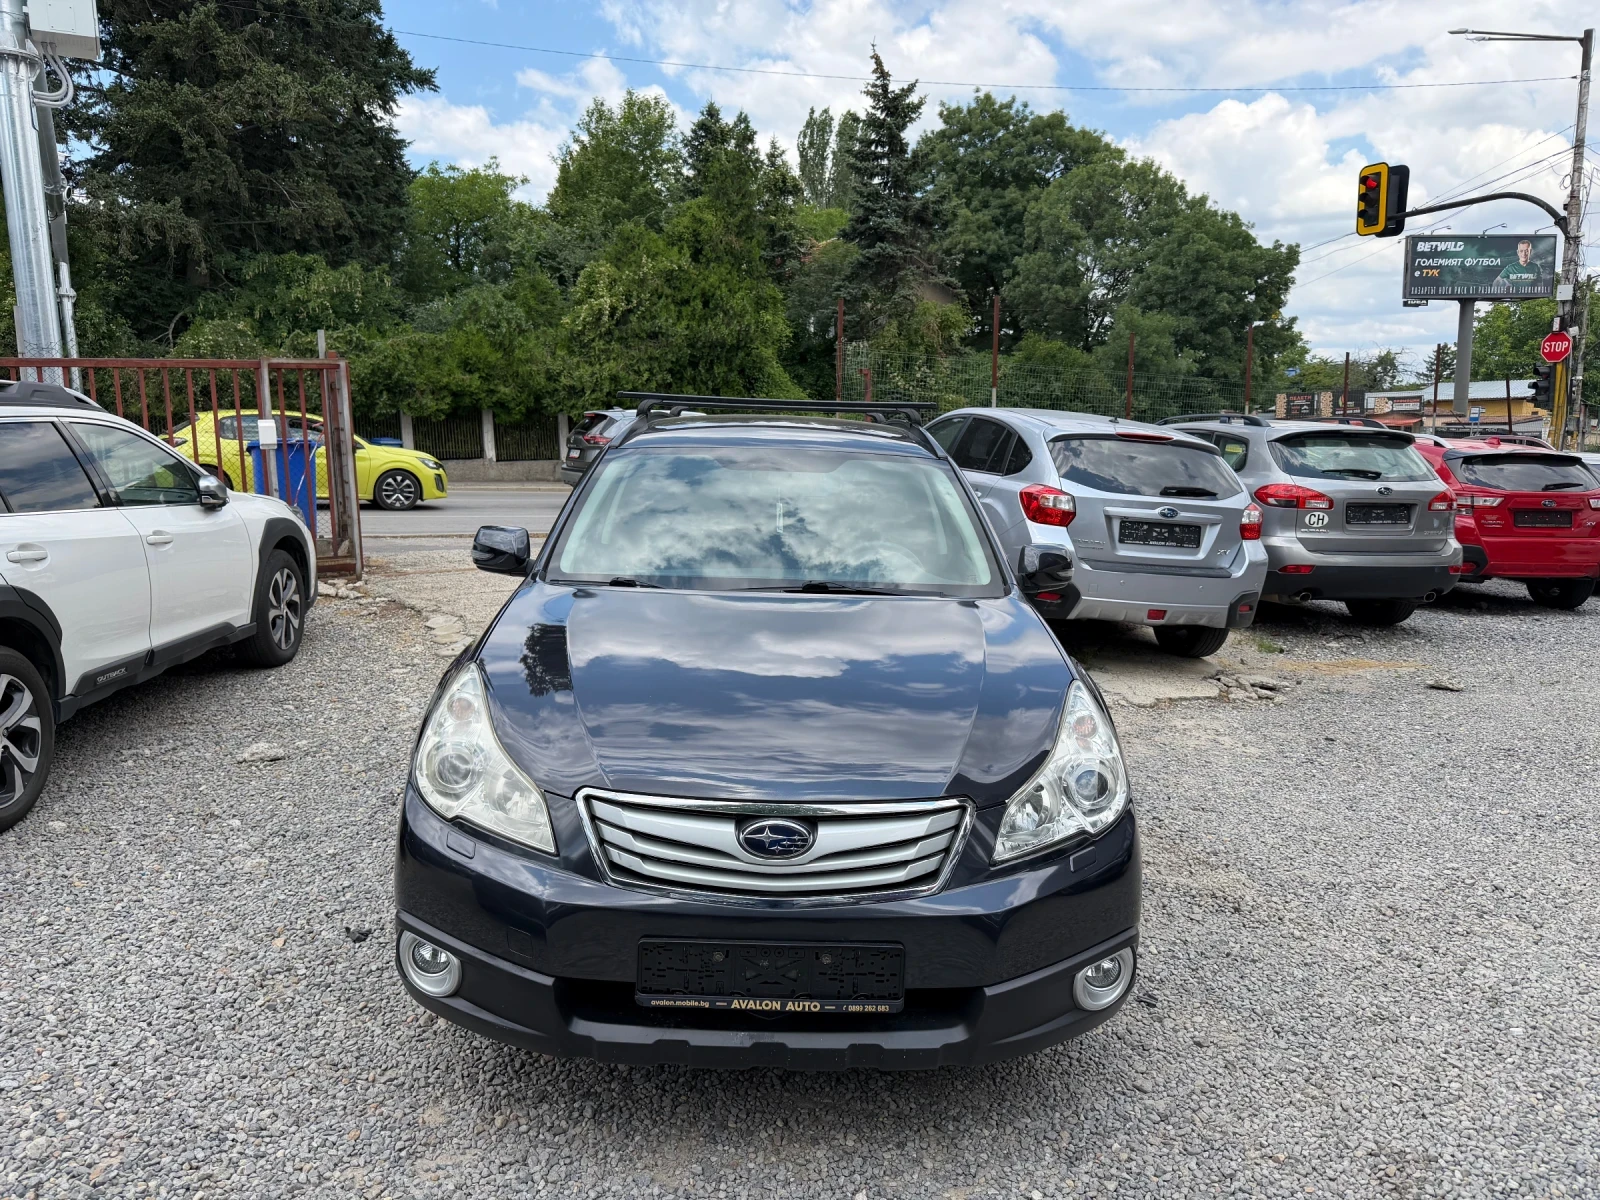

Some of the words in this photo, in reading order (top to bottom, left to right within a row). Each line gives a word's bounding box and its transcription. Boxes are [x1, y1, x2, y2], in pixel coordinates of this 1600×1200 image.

[1416, 241, 1465, 252] BETWILD
[1414, 258, 1464, 266] ГОЛЕМИЯТ
[1464, 257, 1501, 267] ФУТБОЛ
[1422, 269, 1440, 277] ТУК
[1543, 341, 1569, 353] STOP
[1308, 513, 1325, 526] CH
[96, 667, 127, 684] OUTBACK
[650, 999, 710, 1008] avalon.mobile.bg
[731, 999, 781, 1011] AVALON
[785, 1001, 821, 1012] AUTO
